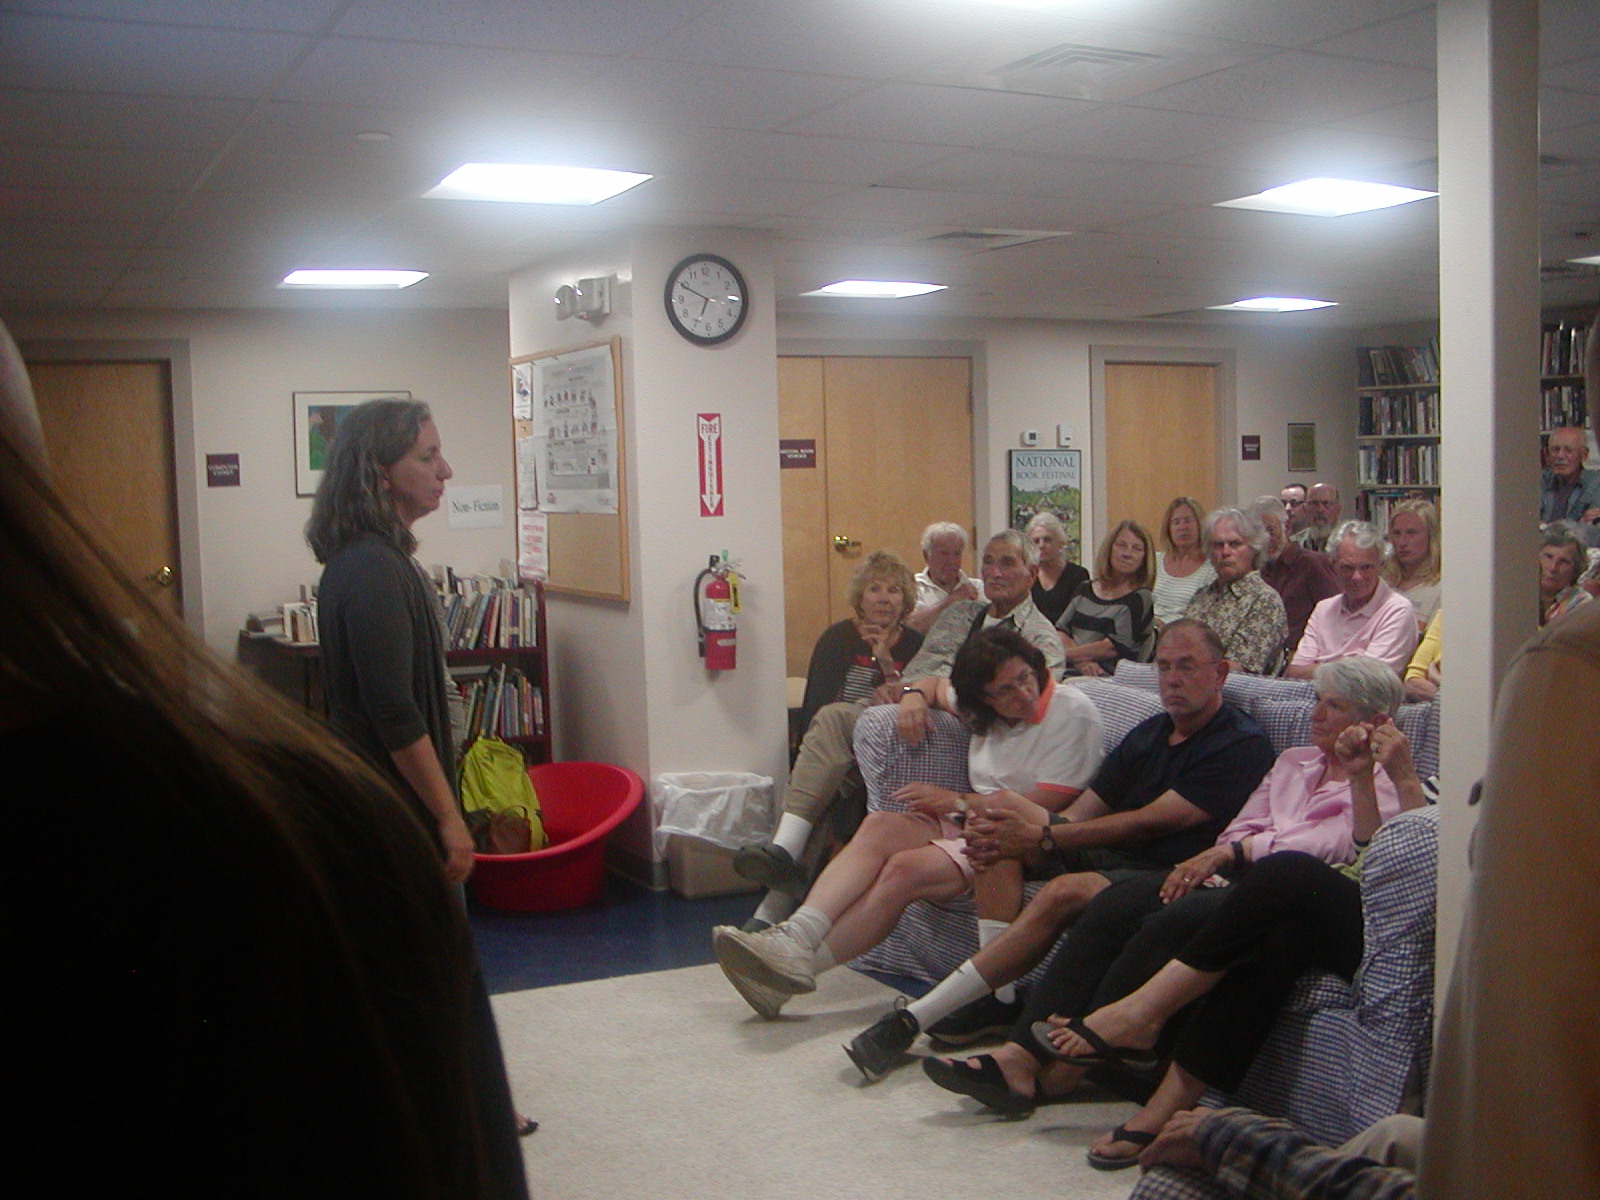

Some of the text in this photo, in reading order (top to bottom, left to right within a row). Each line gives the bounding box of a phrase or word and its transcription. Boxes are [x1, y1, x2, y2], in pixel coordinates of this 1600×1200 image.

[724, 281, 730, 290] 2
[701, 423, 718, 434] FIRE
[1016, 455, 1076, 468] NATIONAL
[1015, 470, 1076, 480] BOOK FESTIVAL
